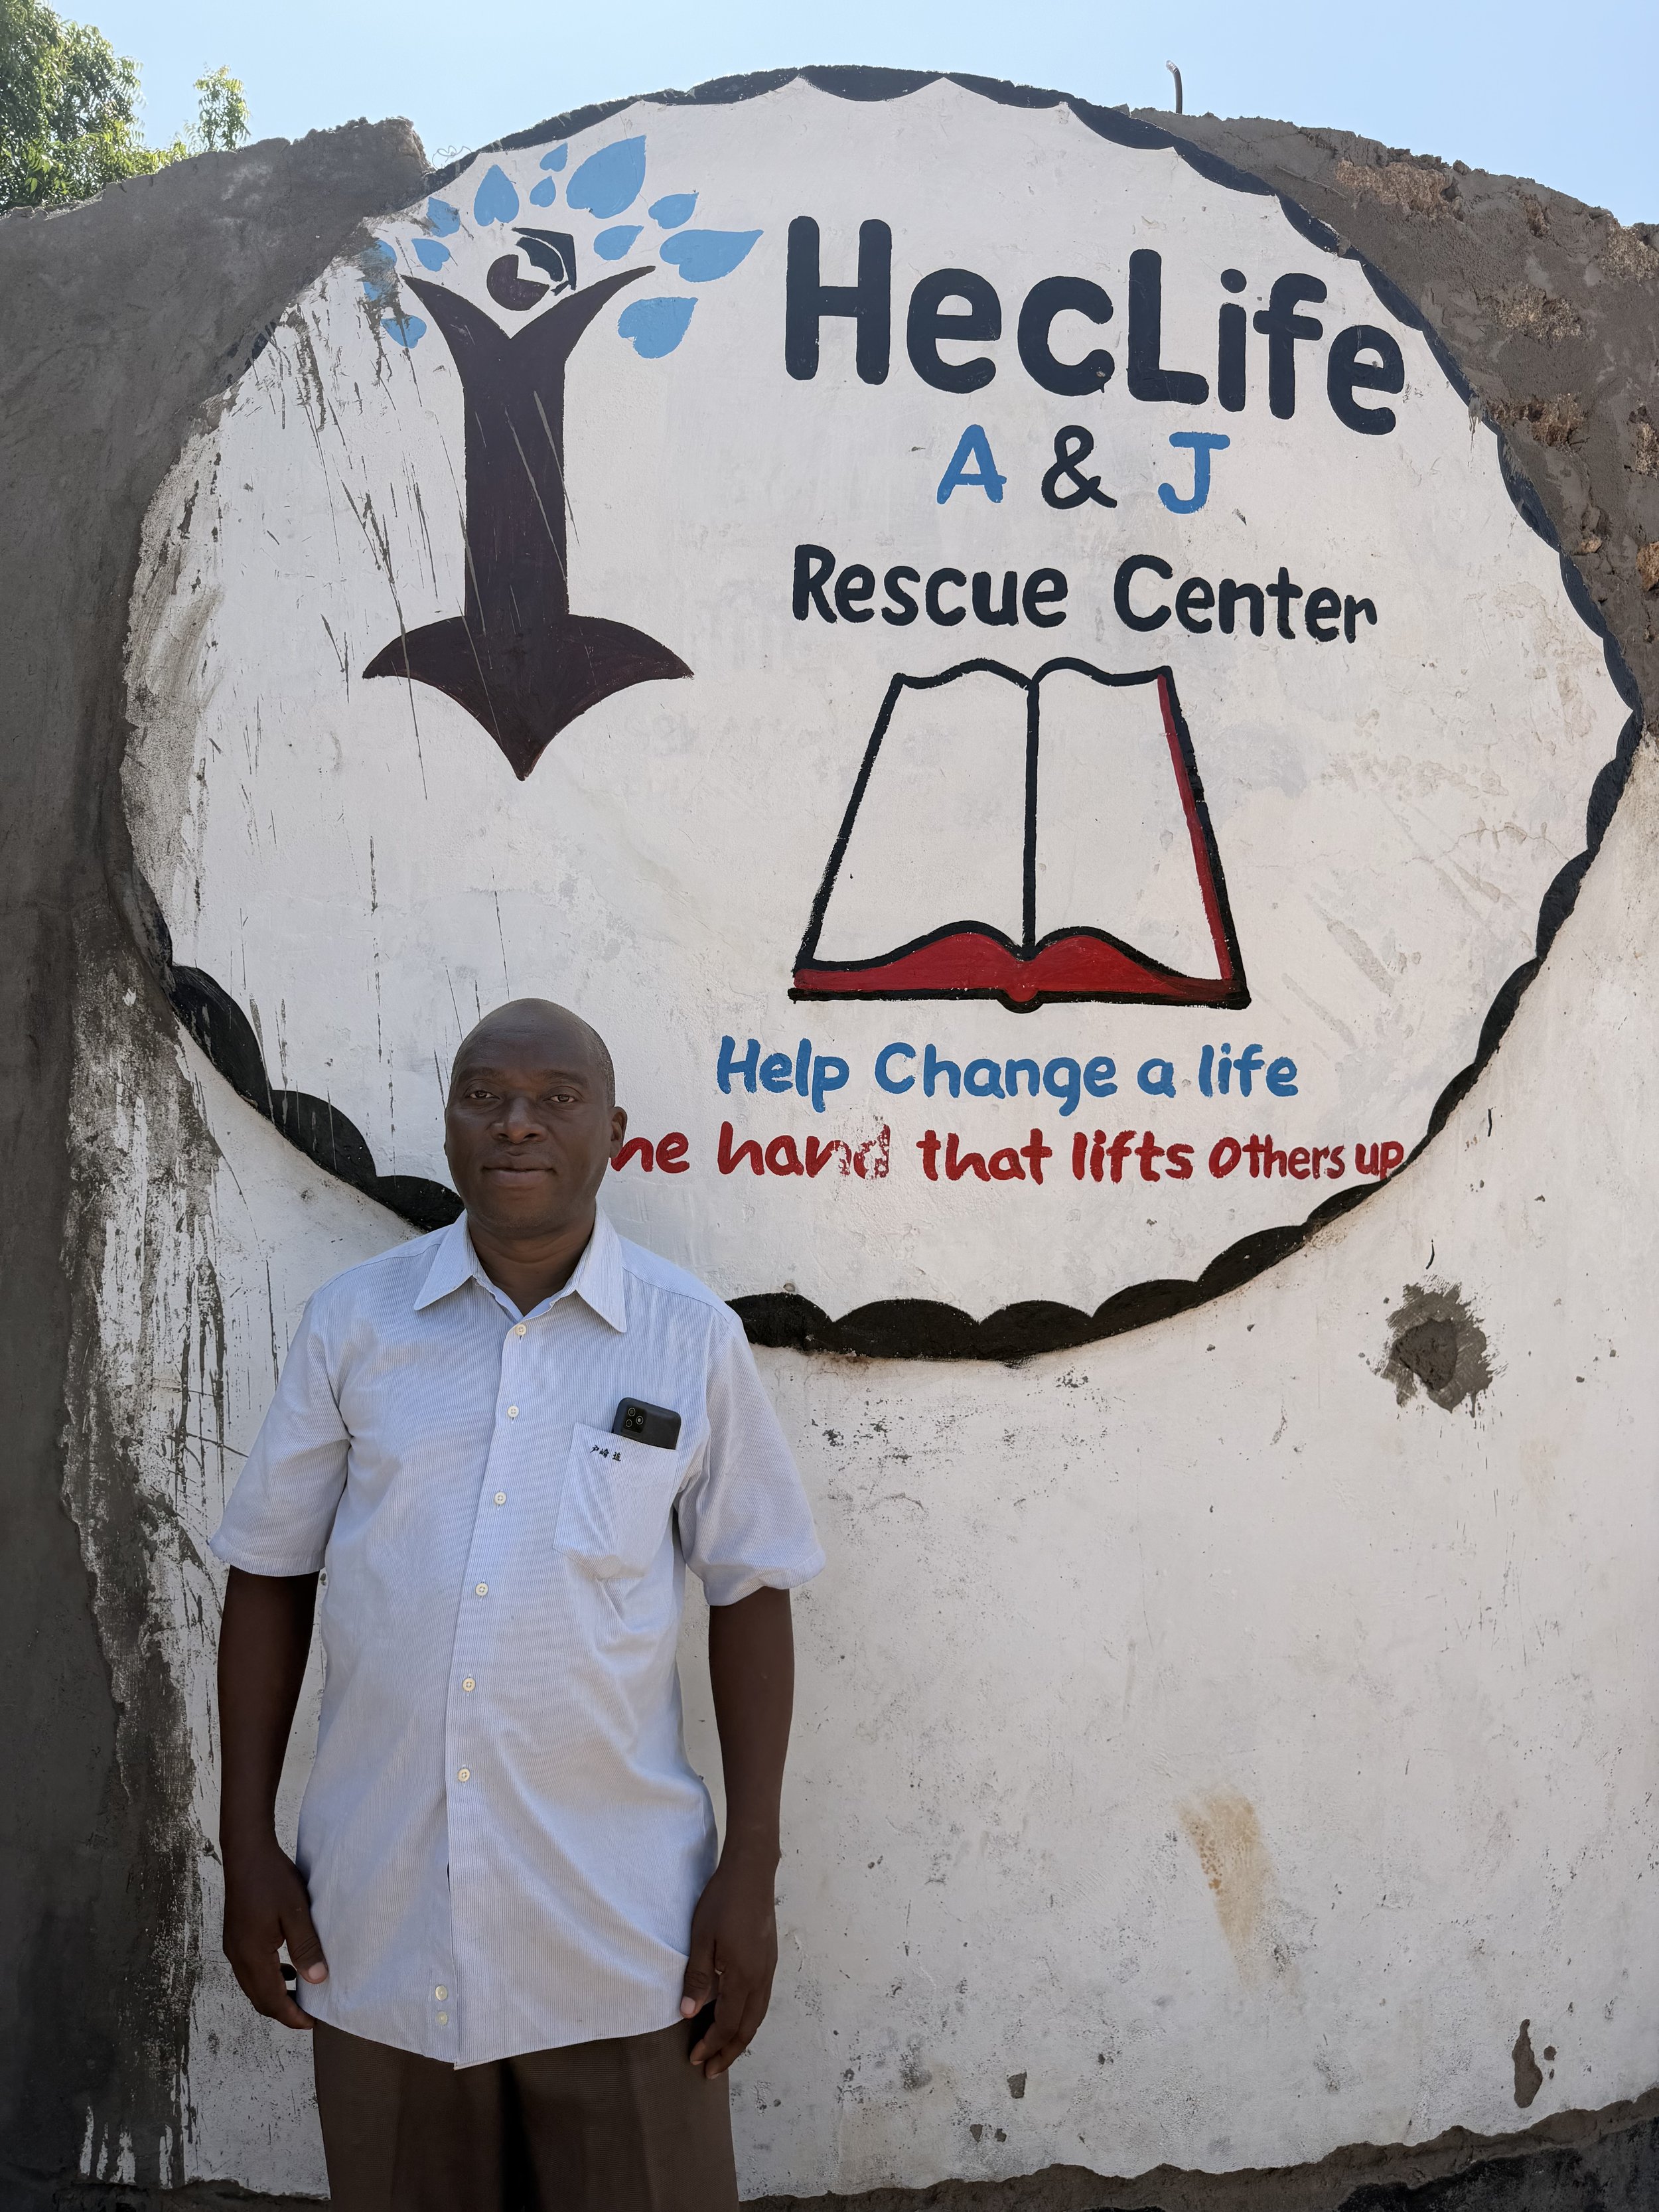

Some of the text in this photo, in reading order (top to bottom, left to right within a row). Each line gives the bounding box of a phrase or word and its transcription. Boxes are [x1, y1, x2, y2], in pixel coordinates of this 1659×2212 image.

[785, 216, 1405, 435] HecLife
[936, 423, 1230, 514] A & J
[792, 544, 1377, 644] Rescue Center
[717, 1035, 1299, 1116] Help Change a life
[717, 1121, 891, 1179] hand
[916, 1128, 1052, 1185] that
[1072, 1130, 1194, 1181] lifts
[1208, 1133, 1346, 1180] Others
[1355, 1141, 1404, 1180] up
